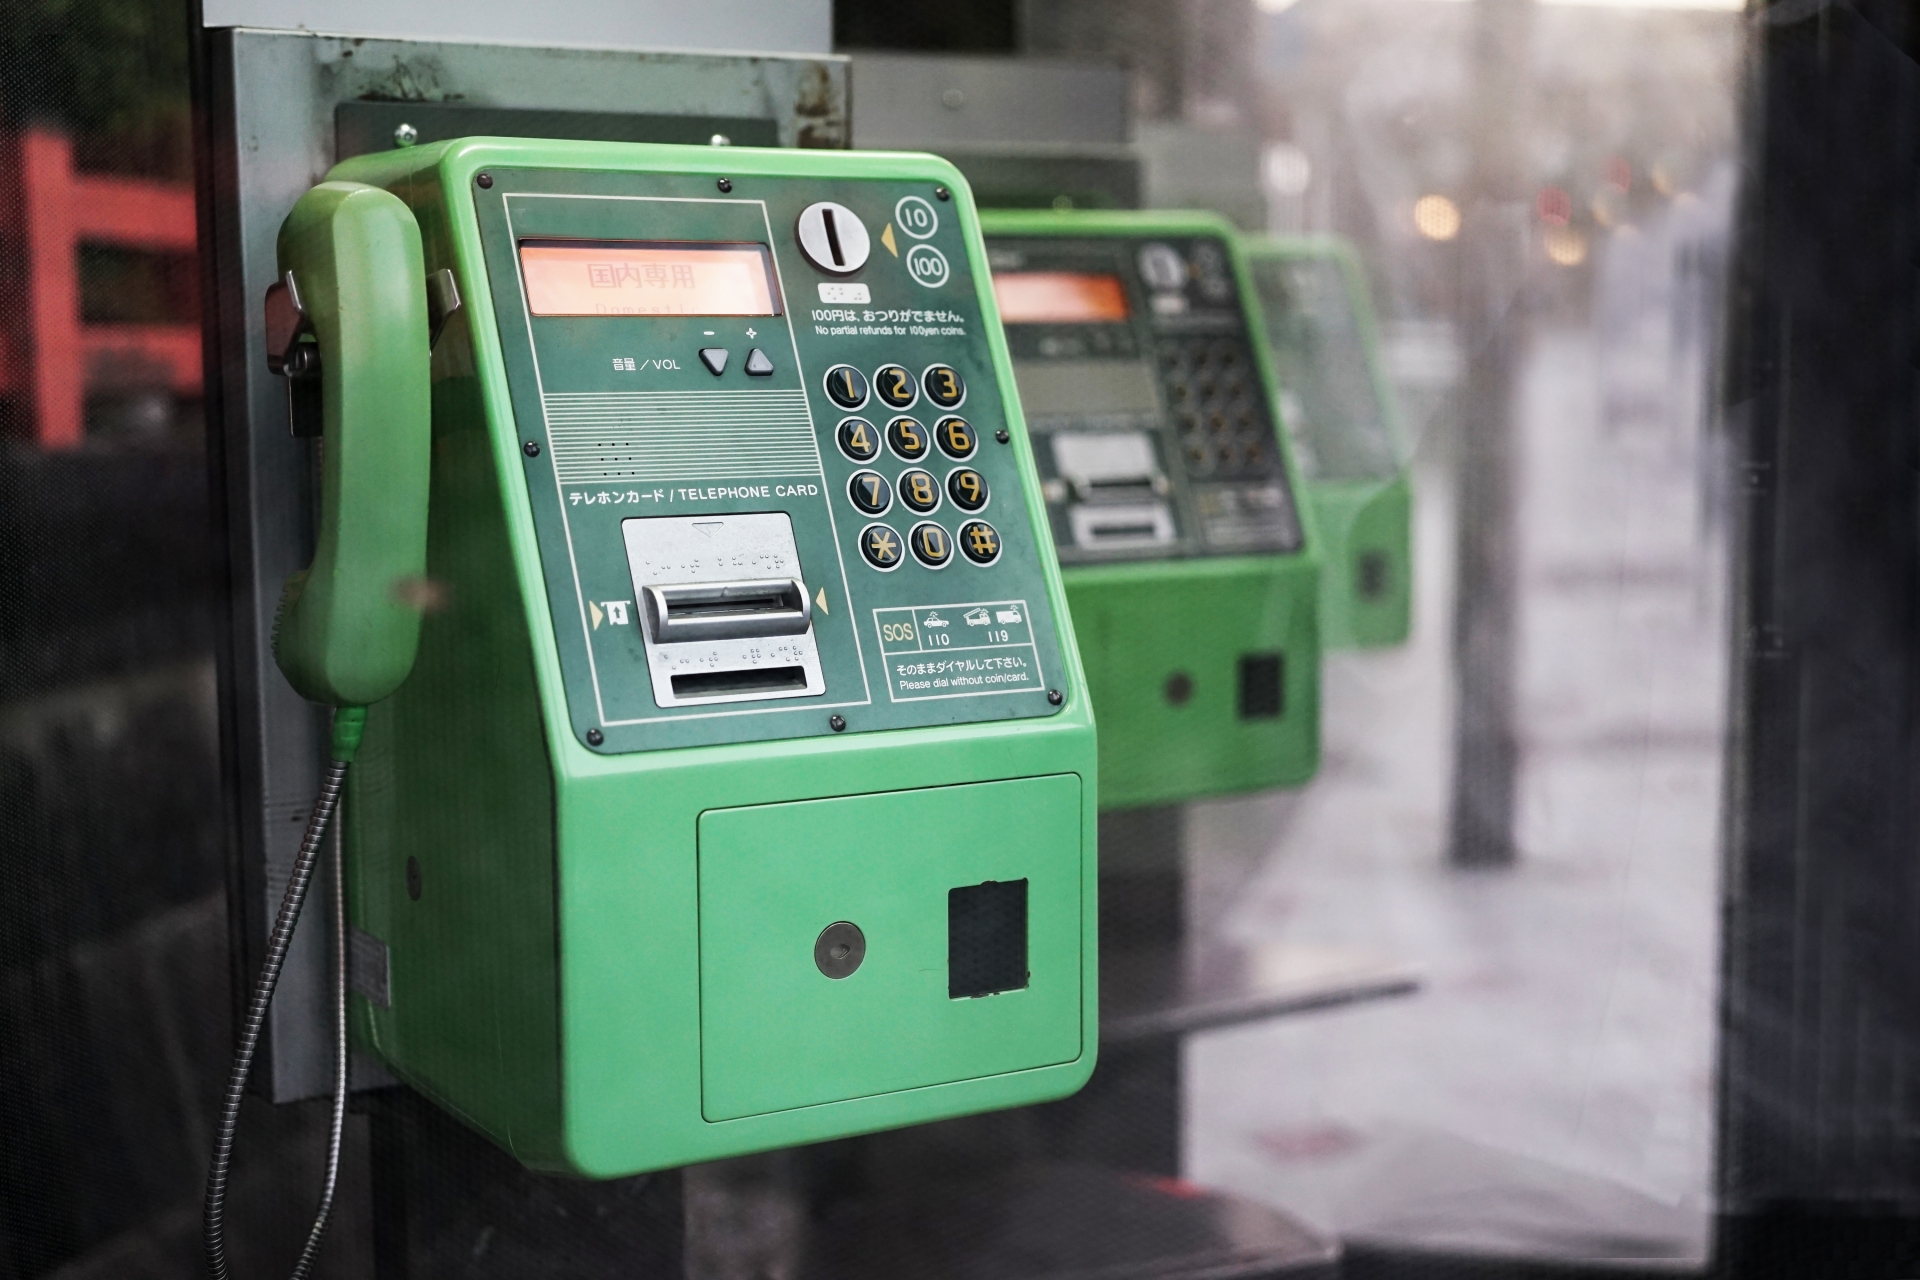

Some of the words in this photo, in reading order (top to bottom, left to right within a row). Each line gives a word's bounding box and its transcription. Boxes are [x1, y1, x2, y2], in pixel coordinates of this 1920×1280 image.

[904, 207, 928, 227] 10
[587, 263, 696, 289] 国内専用
[913, 257, 943, 276] 100
[815, 325, 829, 335] No
[830, 325, 857, 336] partial
[859, 325, 893, 335] refunds
[894, 325, 906, 335] for
[909, 325, 940, 336] 100yen
[941, 326, 966, 335] coins.
[612, 357, 637, 371] 音量
[652, 359, 681, 370] VOL
[844, 370, 855, 398] 1
[889, 369, 910, 399] 2
[938, 369, 958, 398] 3
[851, 424, 871, 453] 4
[900, 421, 920, 450] 5
[948, 421, 970, 450] 6
[569, 489, 665, 506] テレホンカード
[678, 485, 770, 501] TELEPHONE
[776, 484, 818, 498] CARD
[862, 476, 881, 506] 7
[911, 474, 934, 503] 8
[960, 473, 980, 502] 9
[922, 528, 945, 557] 0
[883, 622, 914, 642] SOS
[928, 633, 950, 646] 110
[987, 630, 1009, 643] 119
[896, 656, 1027, 676] そのままダイヤルして下さい。
[899, 679, 931, 690] Please
[933, 678, 949, 687] dial
[950, 675, 984, 687] without
[985, 672, 1029, 685] coin/card.
